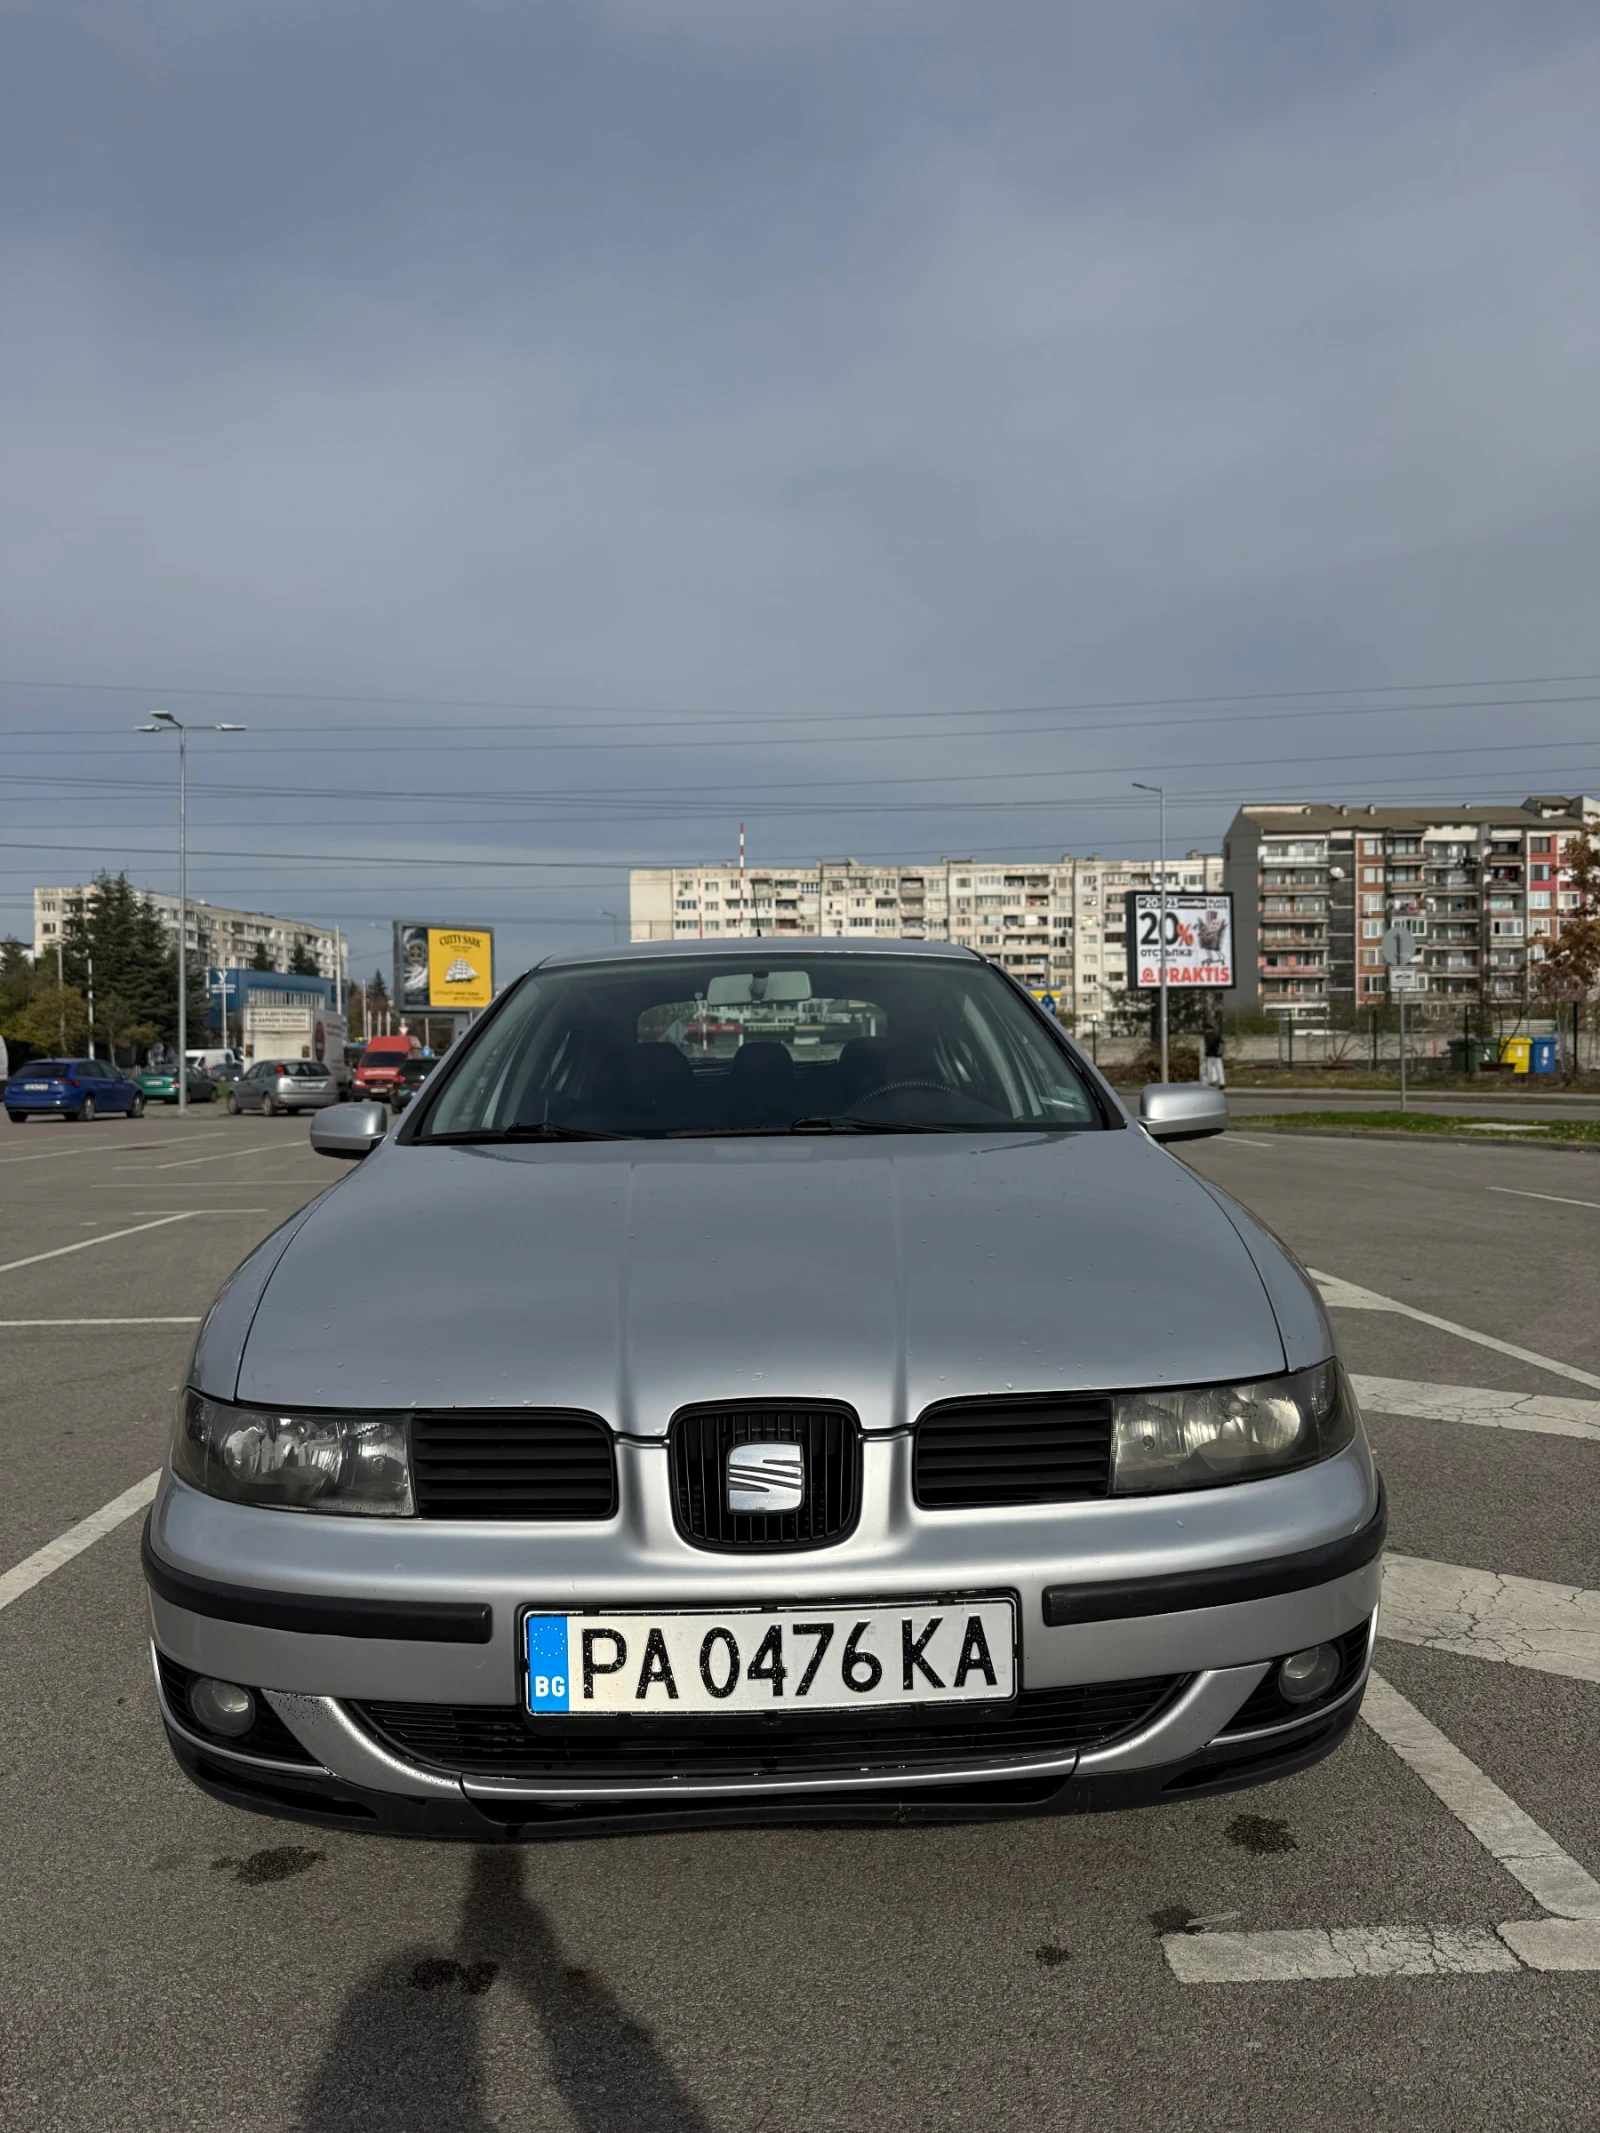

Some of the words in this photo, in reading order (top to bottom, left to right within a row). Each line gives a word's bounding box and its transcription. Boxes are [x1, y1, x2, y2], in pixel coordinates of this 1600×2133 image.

[1146, 897, 1158, 908] 20
[1166, 897, 1178, 908] 23
[1139, 911, 1194, 946] 20%
[439, 934, 461, 946] CUTTY
[463, 935, 481, 948] SARK
[582, 1626, 679, 1699] PA
[700, 1621, 883, 1699] 0476
[902, 1615, 998, 1690] KA
[534, 1676, 566, 1698] BG
